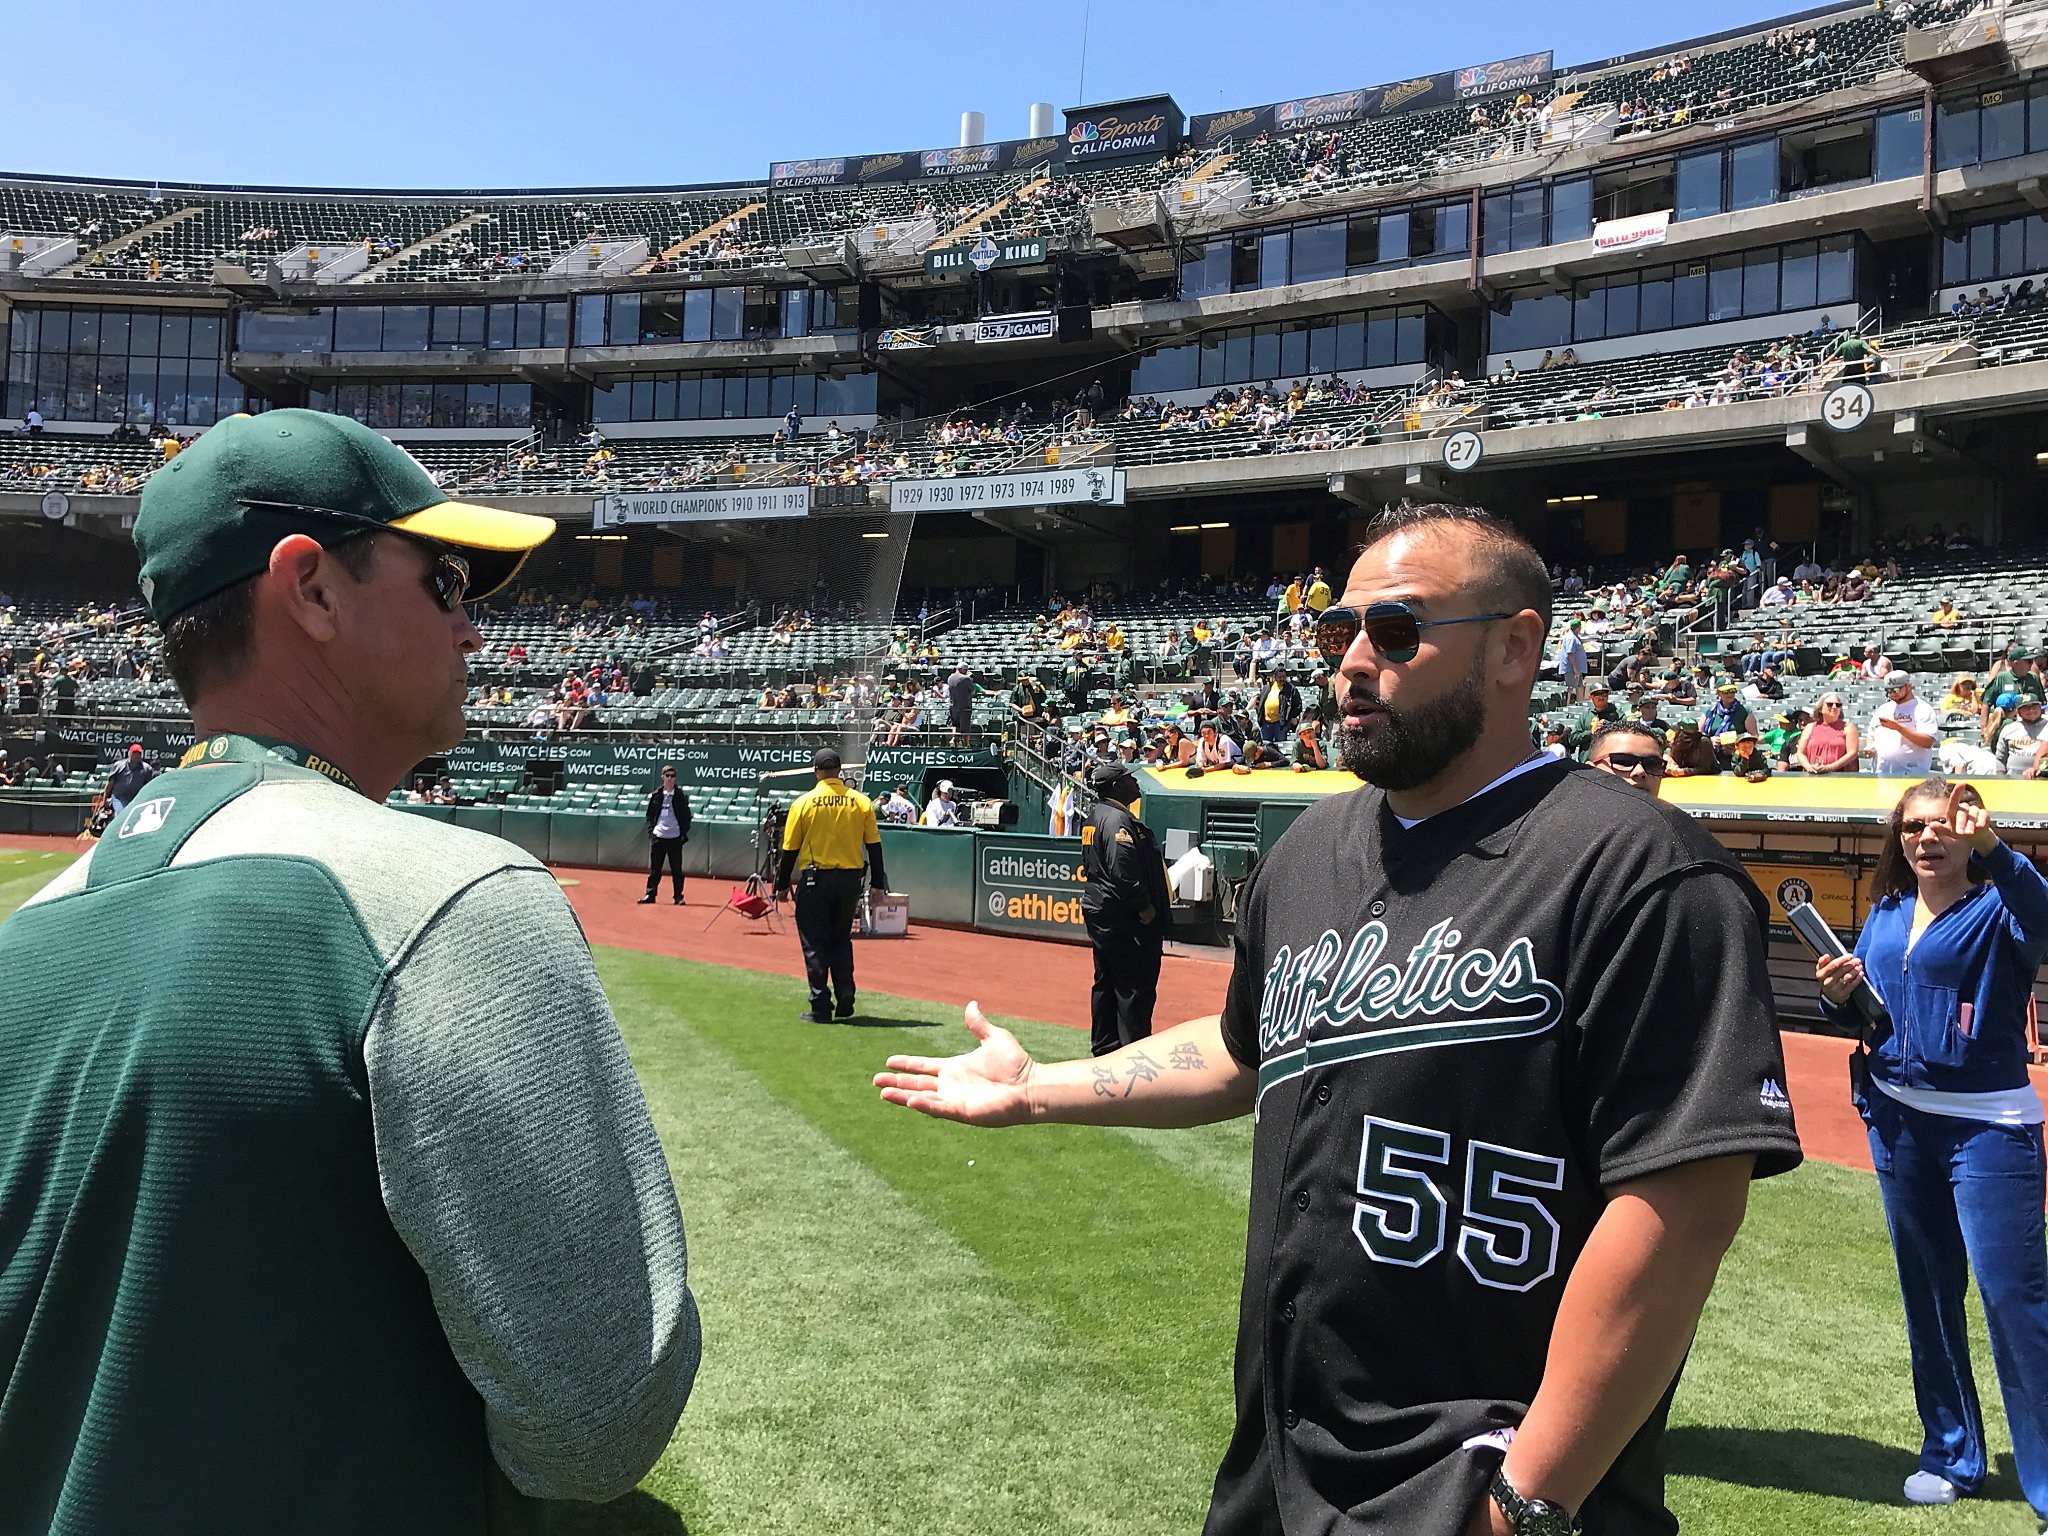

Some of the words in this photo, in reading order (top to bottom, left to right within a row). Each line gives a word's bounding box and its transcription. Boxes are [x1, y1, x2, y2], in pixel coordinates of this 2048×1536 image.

[1462, 74, 1540, 97] CALIFORNIA
[1098, 114, 1165, 141] Sports
[1071, 134, 1156, 155] CALIFORNIA
[926, 162, 989, 177] CALIFORNIA
[775, 175, 835, 188] CALIFORNIA
[933, 252, 964, 268] BILL
[1005, 243, 1040, 260] KING
[980, 325, 1009, 339] 95.7
[1013, 322, 1049, 336] GAME
[1831, 393, 1864, 421] 34
[1449, 439, 1475, 462] 27
[898, 488, 923, 504] 1929
[928, 487, 954, 502] 1930
[959, 485, 985, 501] 1972
[990, 482, 1015, 499] 1973
[1020, 480, 1045, 497] 1974
[1050, 478, 1075, 495] 1989
[632, 500, 668, 515] WORLD
[670, 498, 727, 514] CHAMPIONS
[732, 496, 753, 512] 1910
[757, 495, 777, 510] 1911
[782, 493, 804, 509] 1913
[812, 795, 855, 808] SECURITY
[1767, 813, 1806, 821] ORACLE
[1996, 820, 2041, 829] ORACLE
[1259, 916, 1564, 1053] Athletics
[1352, 1114, 1566, 1293] 55
